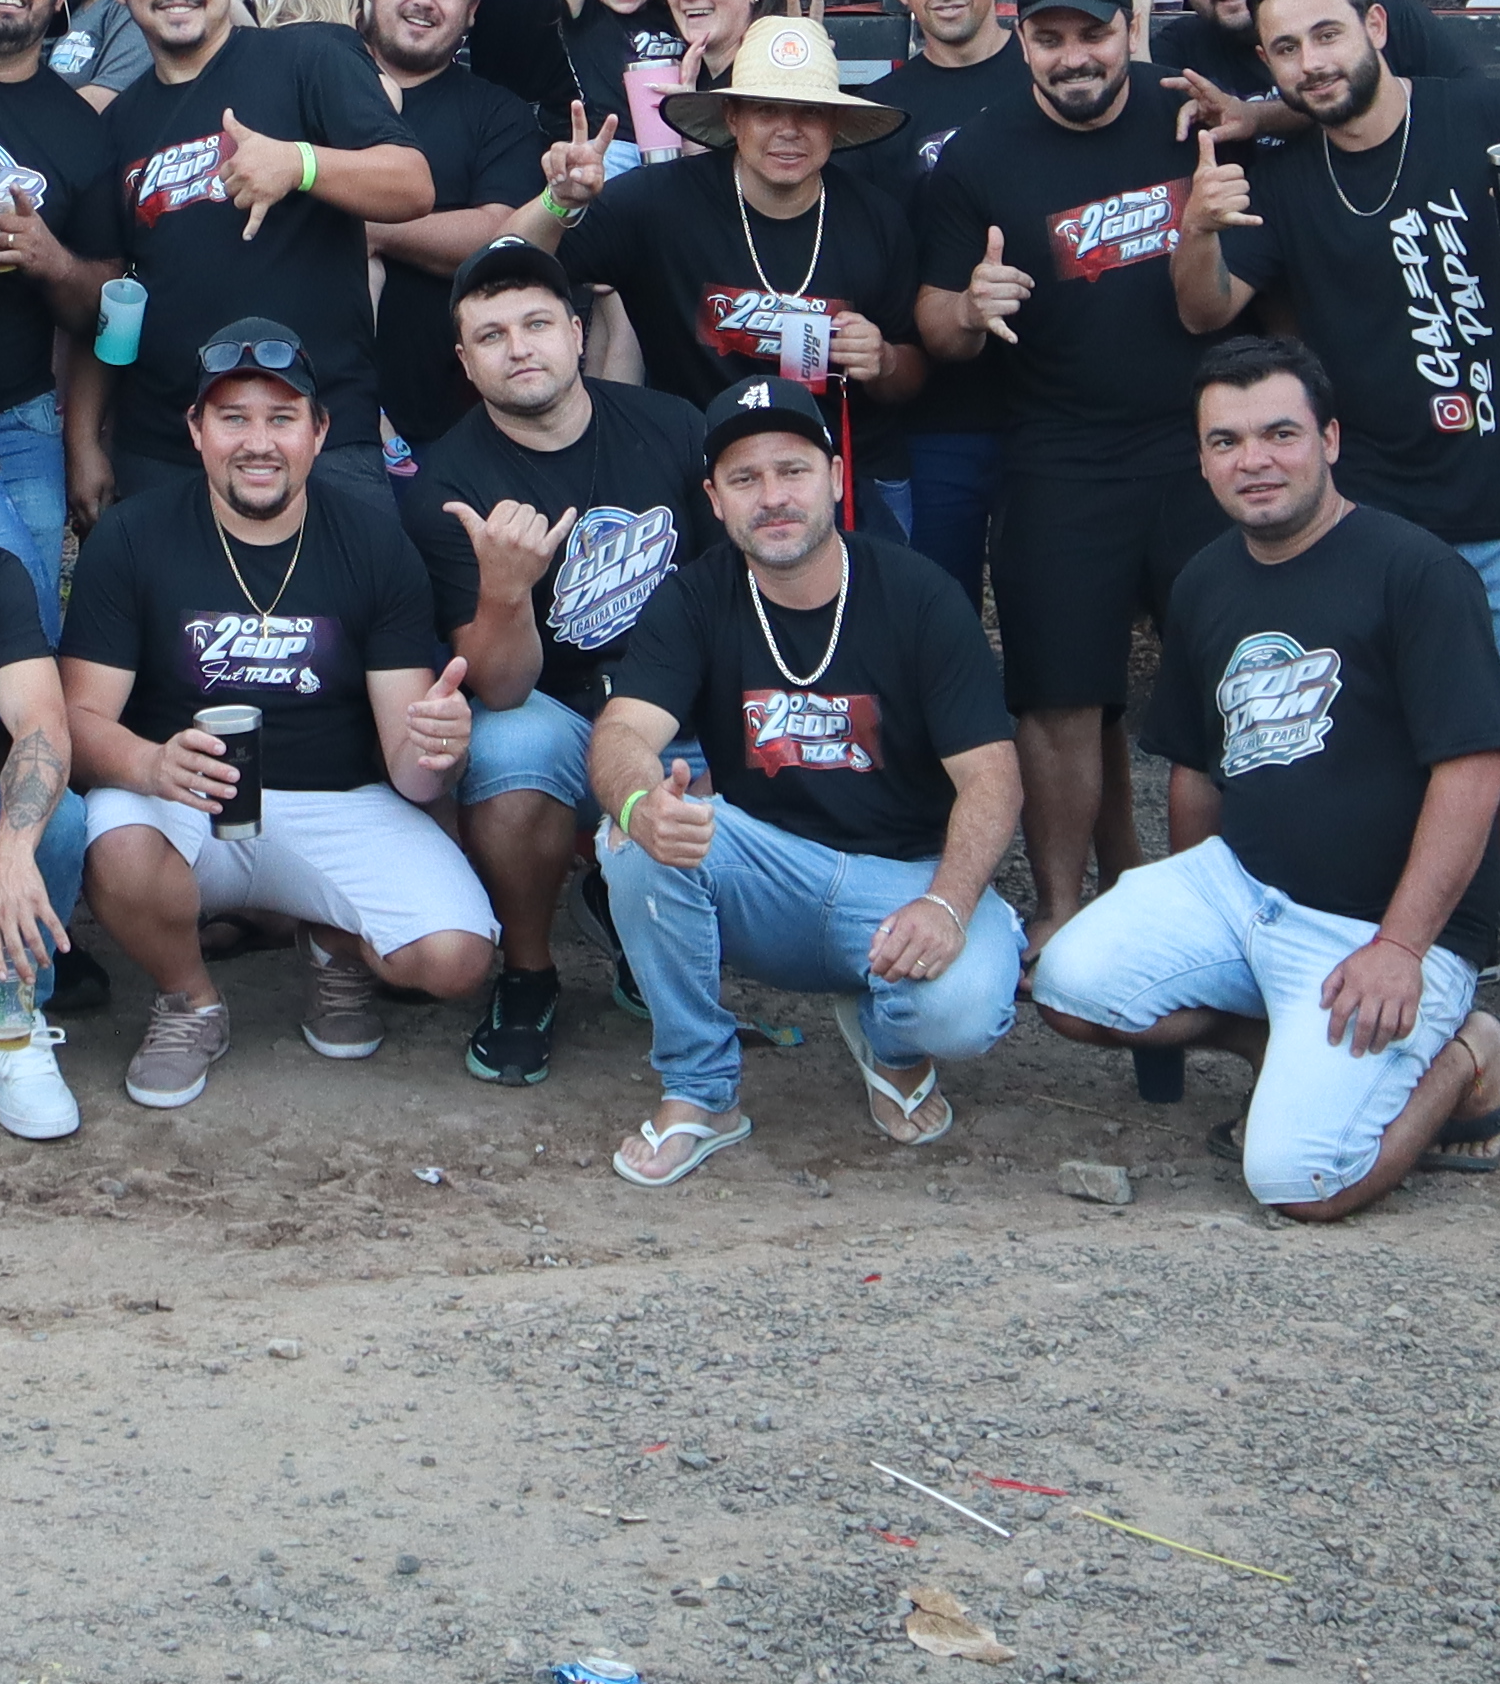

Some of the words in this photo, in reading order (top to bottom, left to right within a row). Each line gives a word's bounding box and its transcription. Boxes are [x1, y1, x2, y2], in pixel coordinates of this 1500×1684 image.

[1100, 202, 1167, 241] GDP
[1119, 230, 1168, 260] TRUCK
[1427, 187, 1494, 346] PAPEL
[801, 322, 814, 381] GUINHO
[811, 336, 822, 369] 072
[229, 635, 307, 660] GDP
[243, 666, 293, 685] TRUCK
[786, 714, 847, 737] GDP
[800, 743, 848, 762] TRUCK
